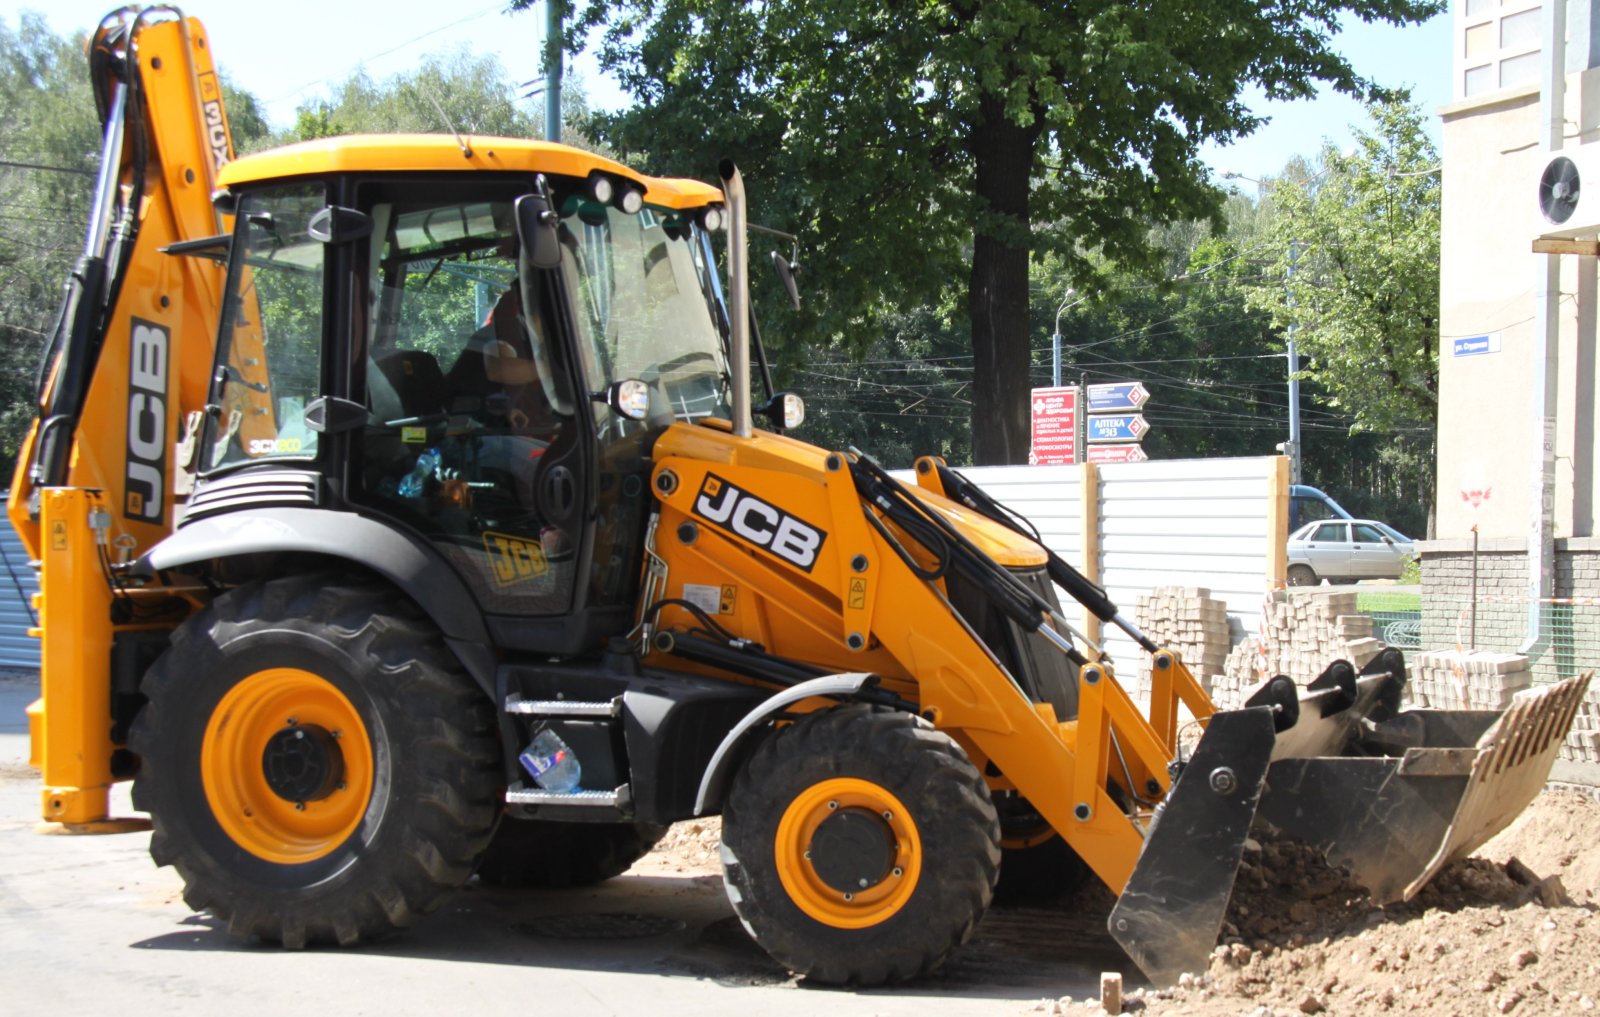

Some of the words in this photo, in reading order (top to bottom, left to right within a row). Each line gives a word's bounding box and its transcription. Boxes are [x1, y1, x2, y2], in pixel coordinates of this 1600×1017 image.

[204, 101, 230, 170] 3CX
[128, 324, 168, 518] JCB
[1094, 418, 1125, 428] АПТЕКА
[494, 537, 545, 580] JCB
[697, 486, 820, 567] JCB
